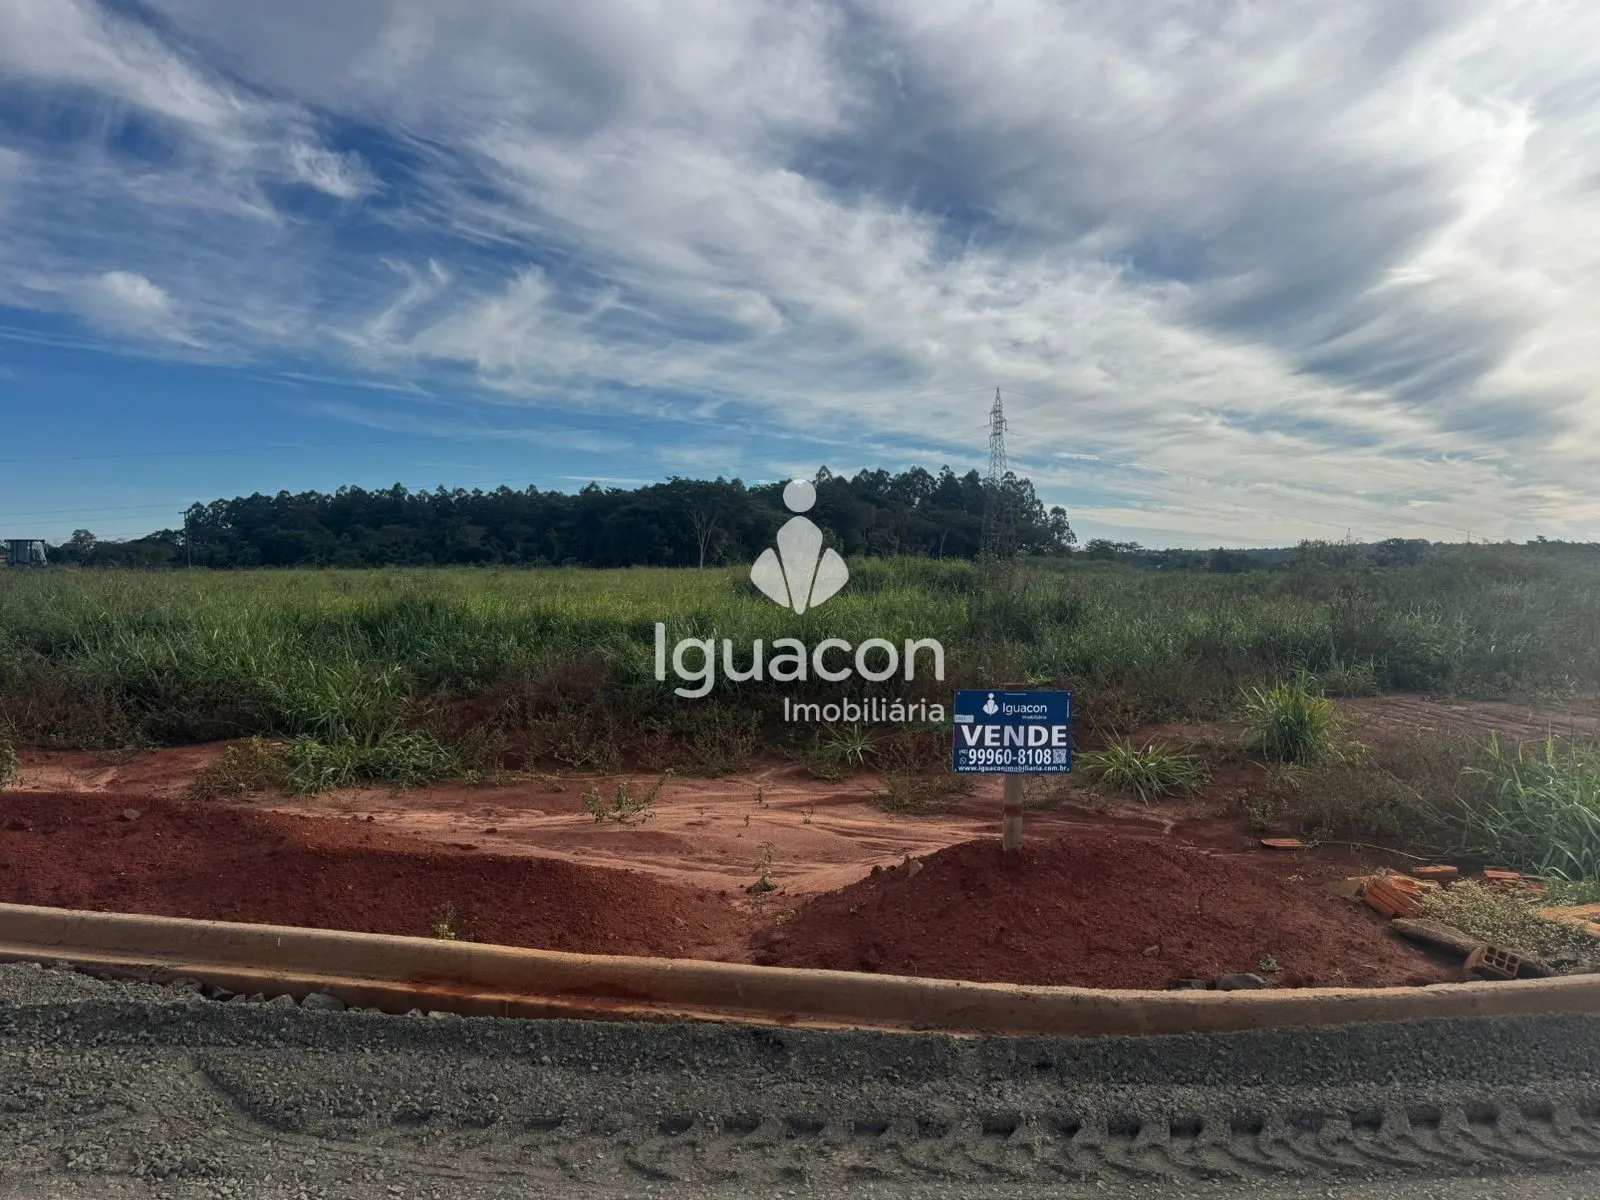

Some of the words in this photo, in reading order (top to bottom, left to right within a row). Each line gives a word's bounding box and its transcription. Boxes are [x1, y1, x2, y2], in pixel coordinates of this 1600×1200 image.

[1002, 702, 1047, 715] Iguacon
[961, 725, 1066, 746] VENDE
[968, 749, 1051, 765] 99960-8108
